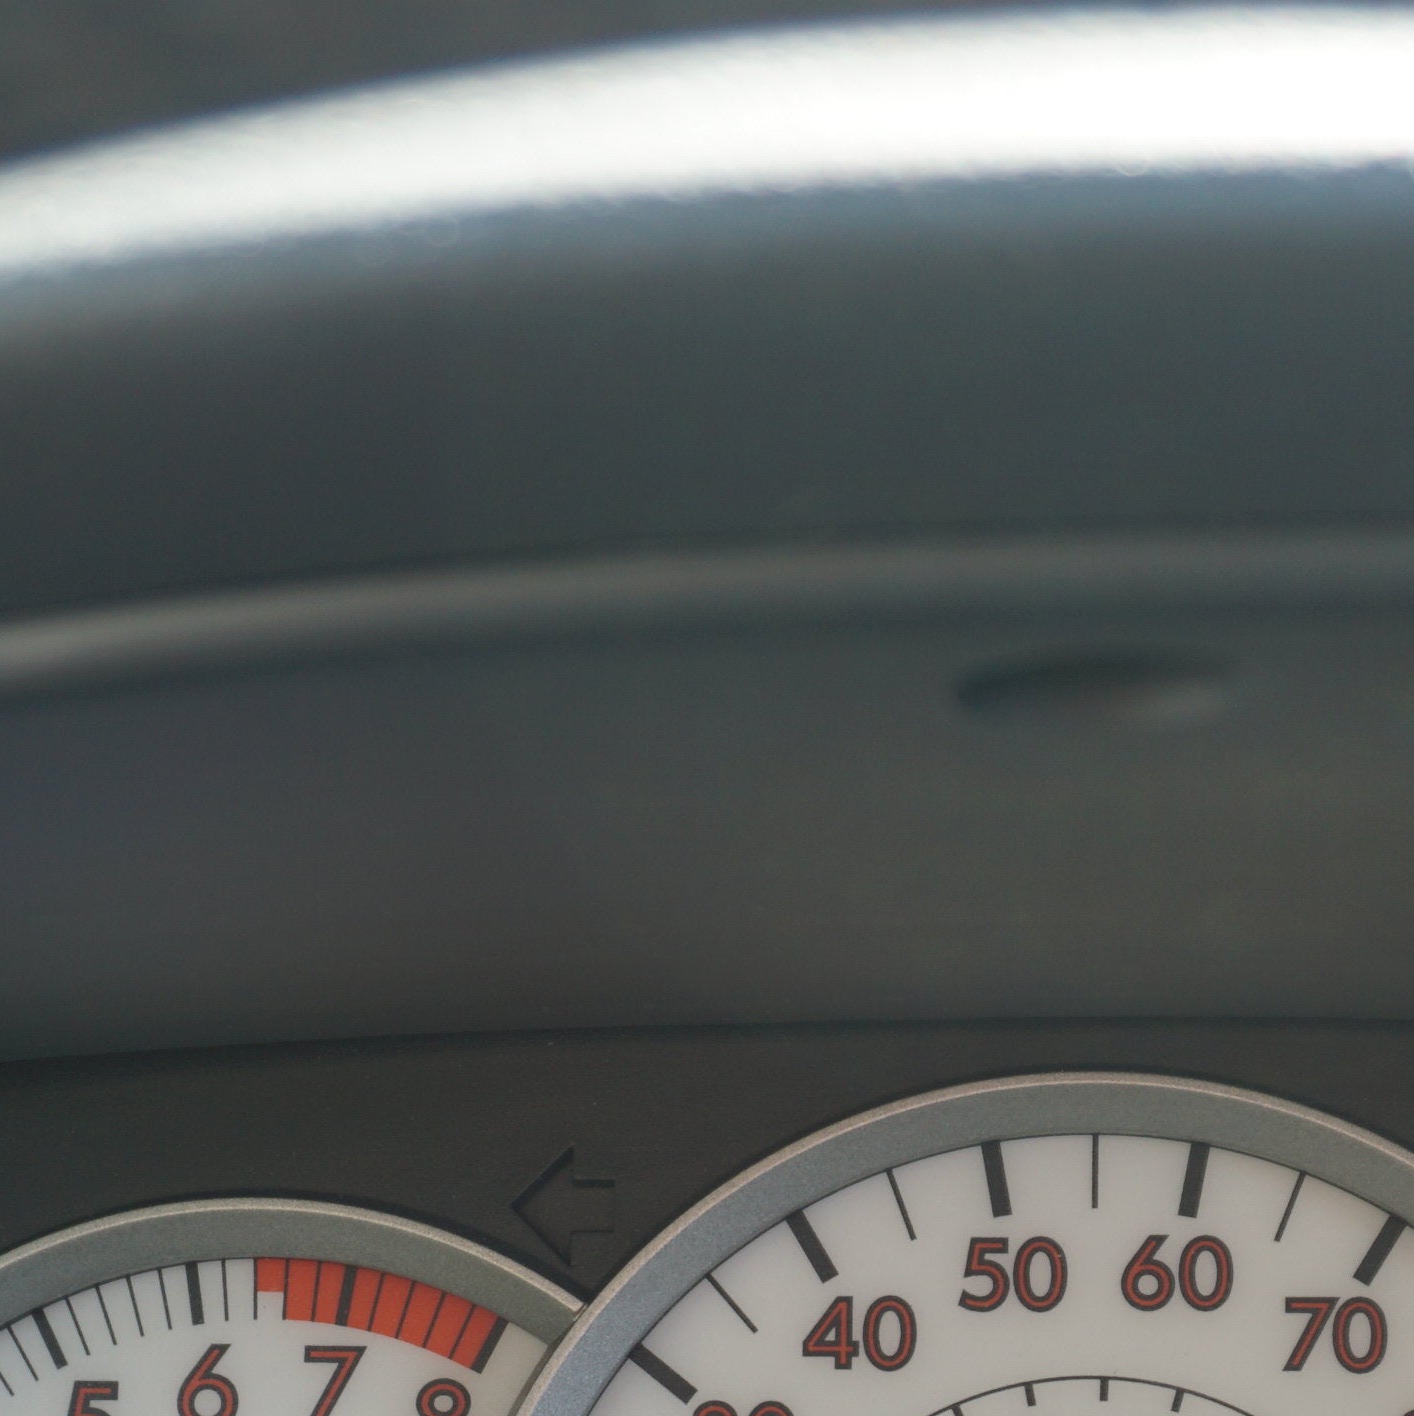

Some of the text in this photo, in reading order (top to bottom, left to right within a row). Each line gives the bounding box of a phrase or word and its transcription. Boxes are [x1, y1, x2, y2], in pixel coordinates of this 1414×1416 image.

[958, 1236, 1067, 1312] 50
[1121, 1235, 1233, 1312] 60
[803, 1295, 917, 1371] 40
[1283, 1297, 1387, 1374] 70
